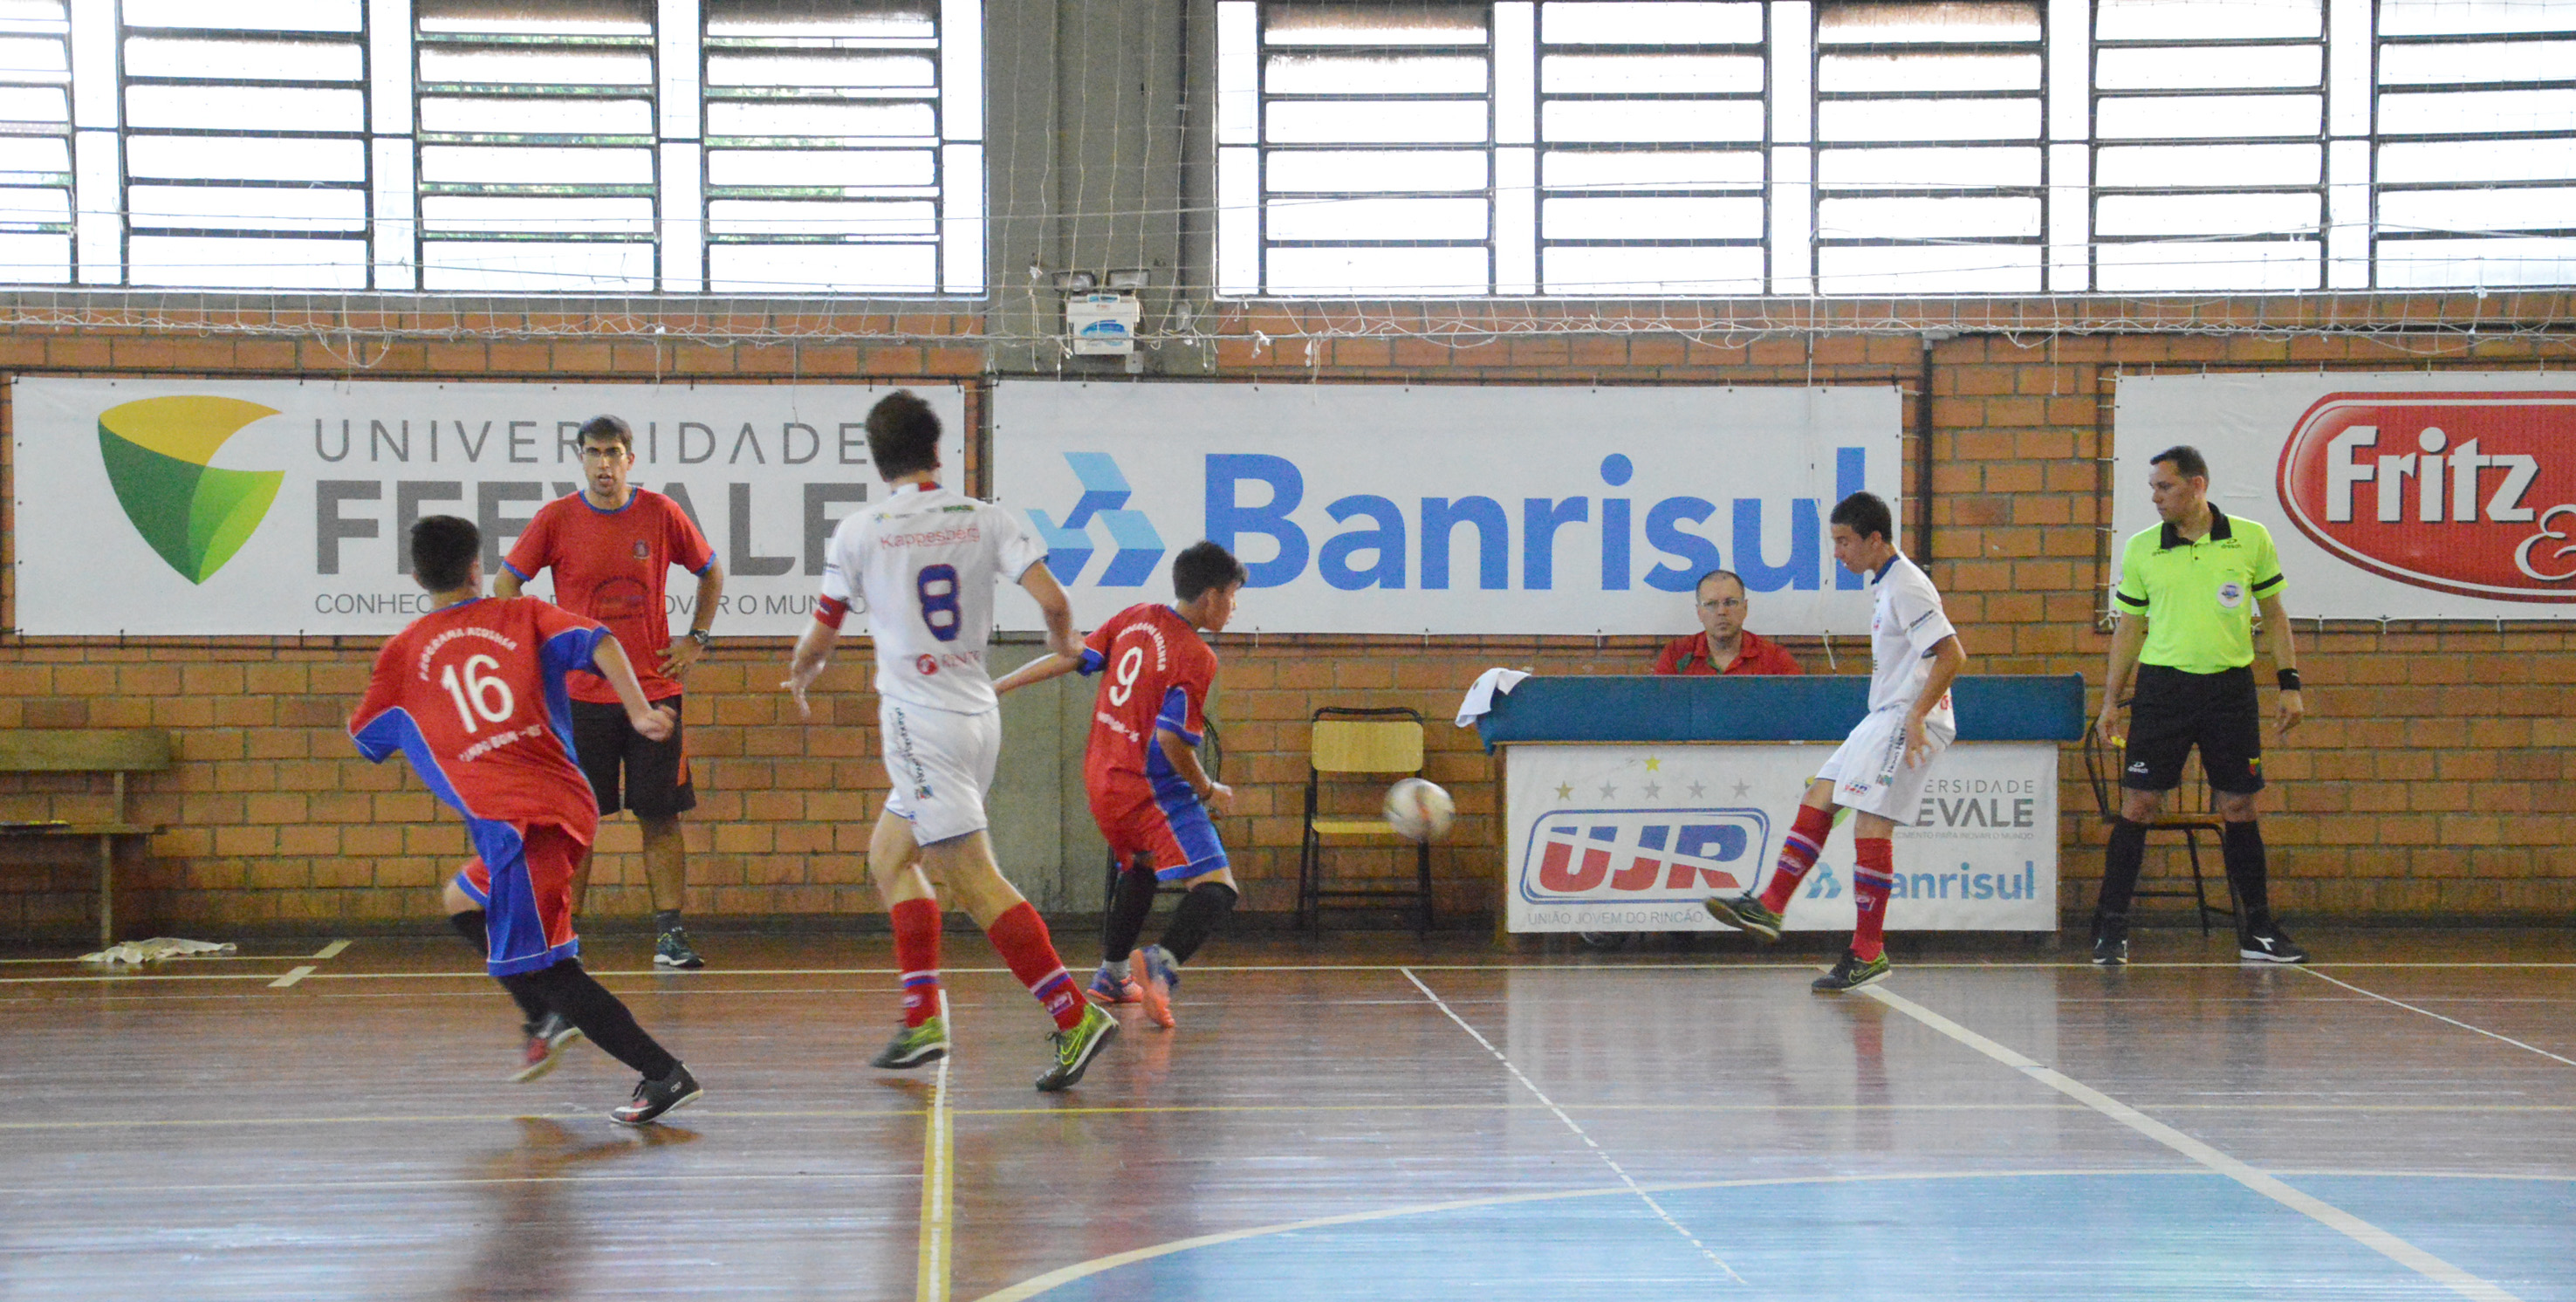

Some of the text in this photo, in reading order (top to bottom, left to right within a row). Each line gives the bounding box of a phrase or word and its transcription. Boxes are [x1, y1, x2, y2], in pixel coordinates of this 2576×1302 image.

[315, 418, 867, 465] UNIVERIDADE
[2326, 425, 2539, 523] Fritz
[880, 526, 981, 549] Kappesberg
[1205, 447, 1865, 592] Banrisul
[738, 595, 757, 614] O
[917, 564, 961, 641] 8
[440, 654, 515, 734] 16
[1108, 646, 1143, 707] 9
[1923, 779, 2034, 794] ERSIDADE
[1915, 798, 2034, 827] EVALE
[1538, 824, 1747, 893] UJR
[1890, 860, 2034, 900] anrisul
[1528, 912, 1571, 925] UNIÃO
[1574, 912, 1621, 924] JOVEM
[1627, 912, 1646, 923] DO
